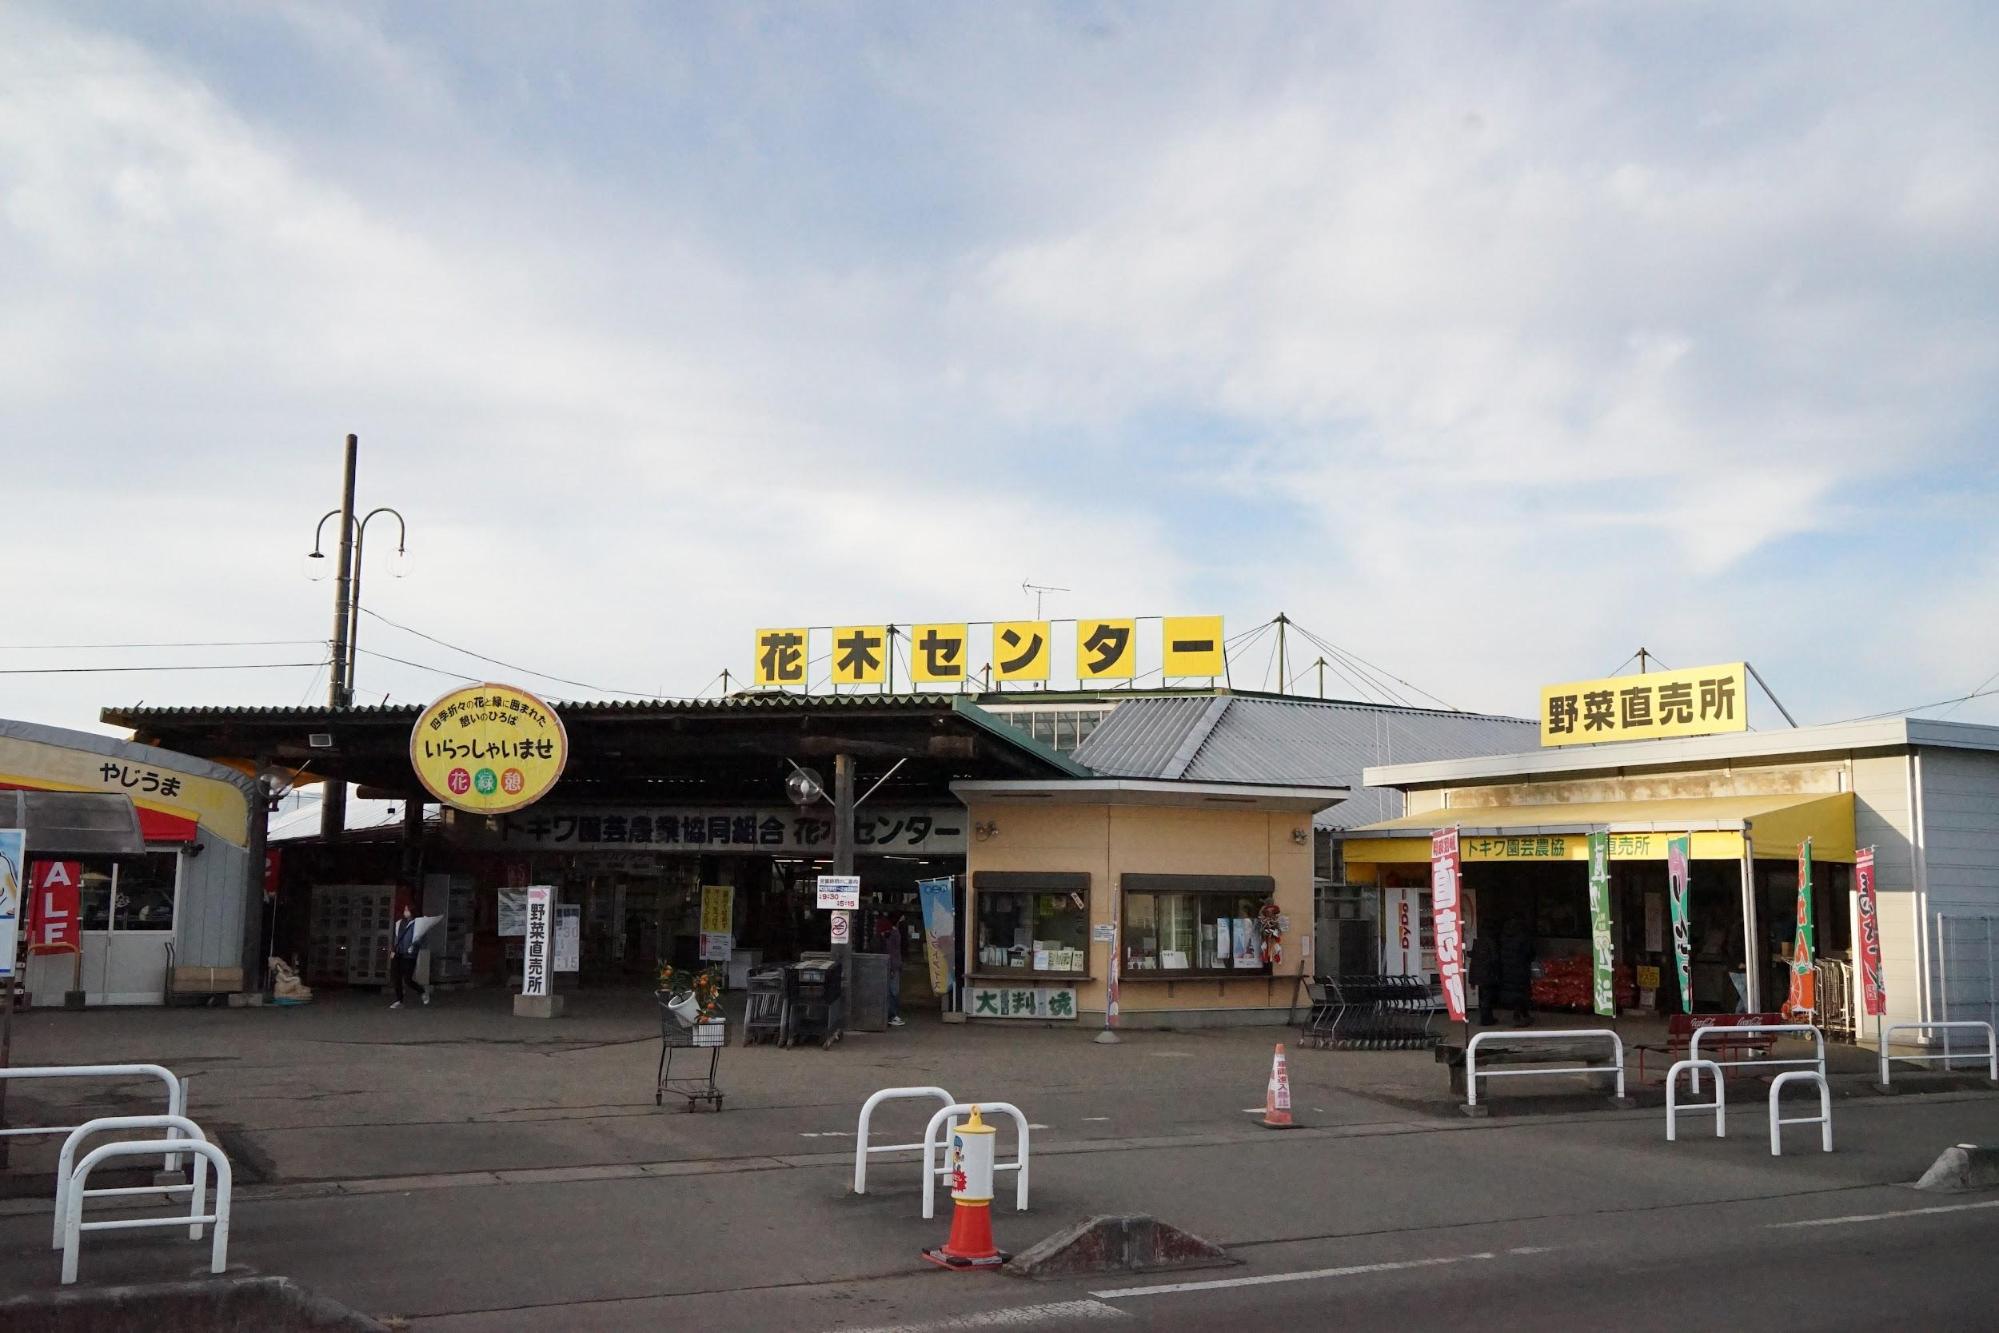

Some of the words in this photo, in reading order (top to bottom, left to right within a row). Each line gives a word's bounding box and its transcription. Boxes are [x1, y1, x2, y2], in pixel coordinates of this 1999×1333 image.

[760, 624, 1214, 681] 花木センター
[430, 696, 547, 731] 四季折々の花と緑に囲まれた
[459, 711, 519, 728] 憩いのひろば
[1549, 676, 1736, 734] 野菜直売所
[425, 738, 554, 760] いらっしゃいませ
[100, 762, 181, 798] やじうま
[1468, 838, 1565, 857] トキワ園芸農協
[1401, 902, 1411, 950] DyDo
[526, 903, 545, 993] 野菜直売所
